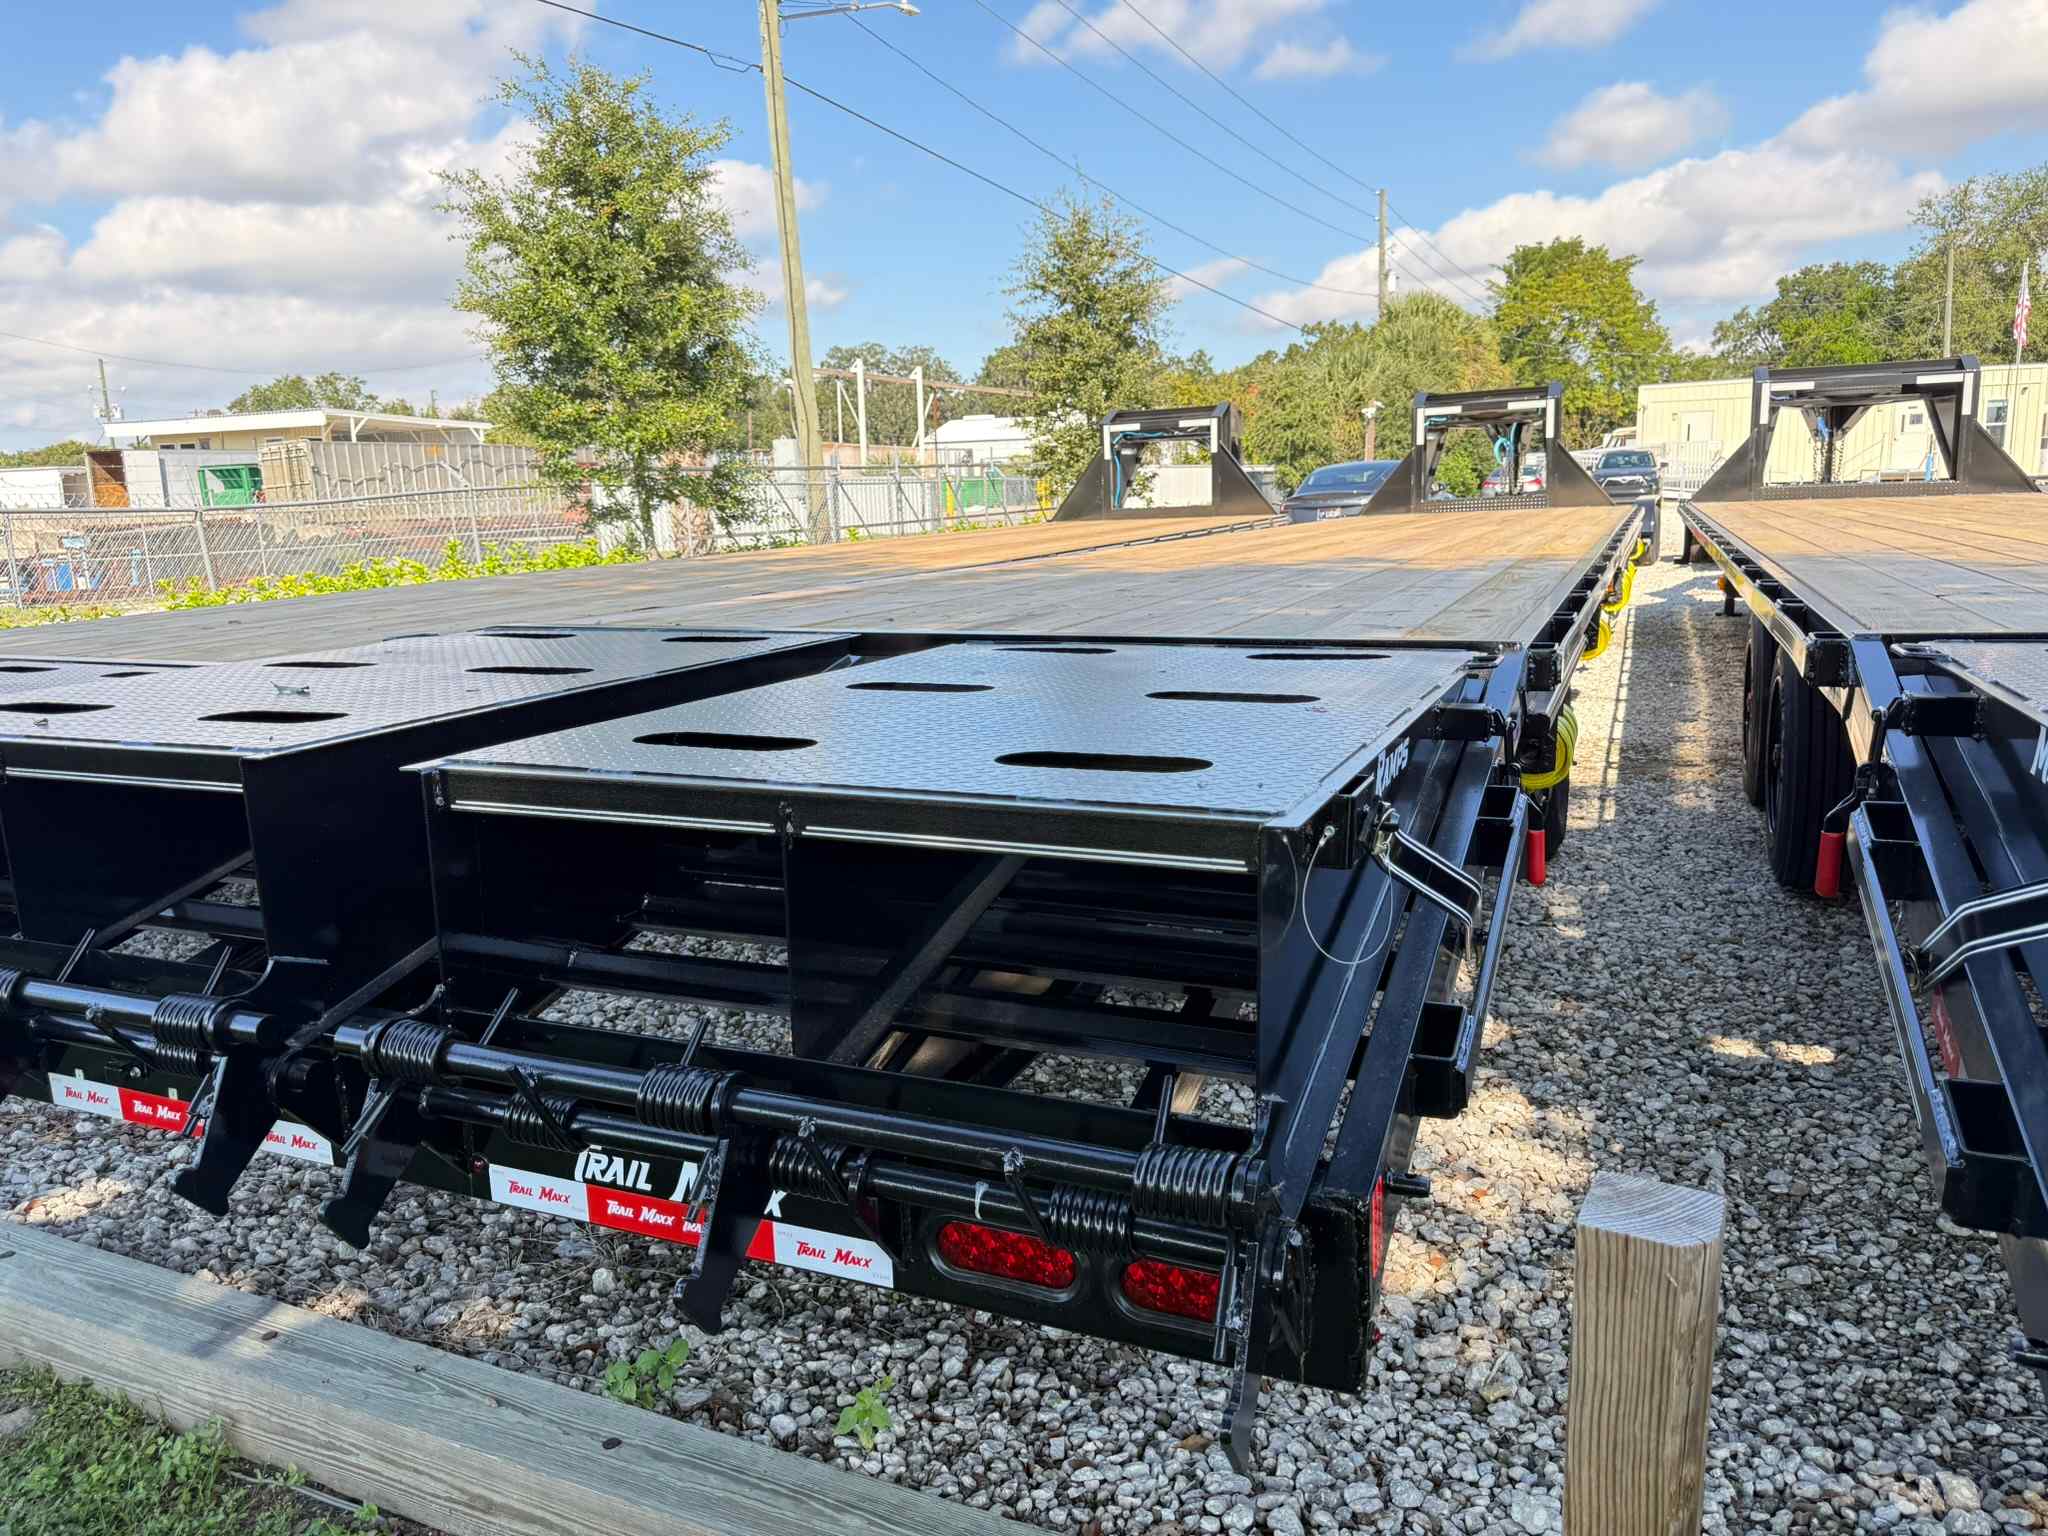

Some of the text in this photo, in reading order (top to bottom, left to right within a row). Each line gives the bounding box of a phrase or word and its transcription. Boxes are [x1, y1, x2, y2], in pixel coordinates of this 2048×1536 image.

[1375, 736, 1410, 797] RAMPS
[64, 1086, 109, 1105] TRAIL MAXX
[133, 1100, 182, 1121] TRAIL MAXX
[291, 1134, 317, 1150] MAXX
[508, 1180, 571, 1204] TRAIL MAXX
[606, 1199, 635, 1219] TRAIL
[638, 1206, 676, 1227] MAXX
[796, 1240, 872, 1269] TRAIL MAXX
